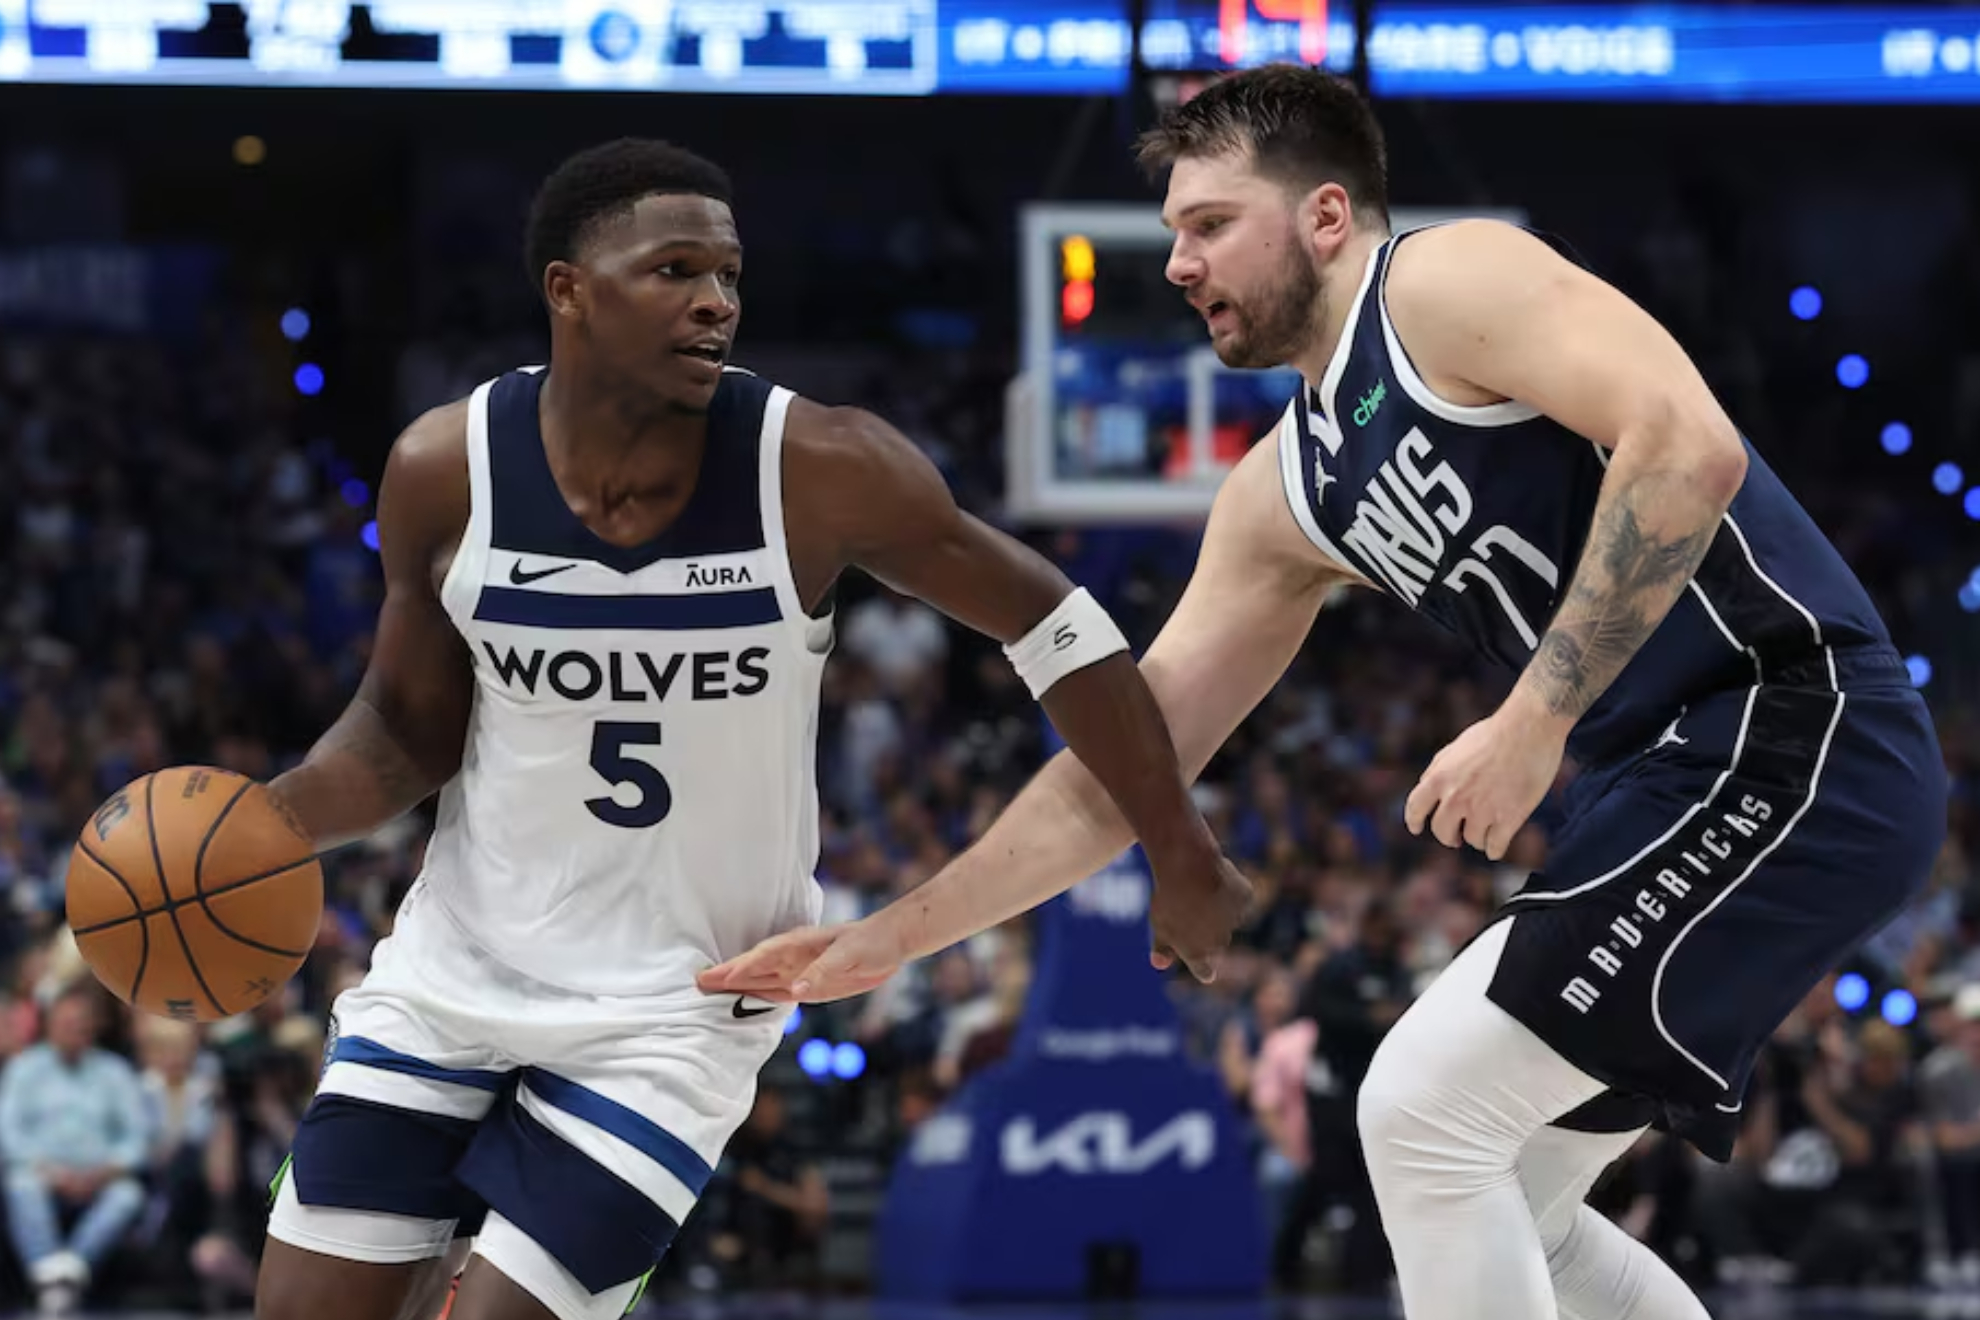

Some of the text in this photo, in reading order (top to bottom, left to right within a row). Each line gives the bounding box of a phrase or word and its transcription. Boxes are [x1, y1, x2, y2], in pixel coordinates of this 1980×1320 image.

[1442, 524, 1559, 651] 77
[481, 640, 771, 702] WOLVES
[1053, 622, 1078, 653] 5
[584, 719, 672, 829] 5
